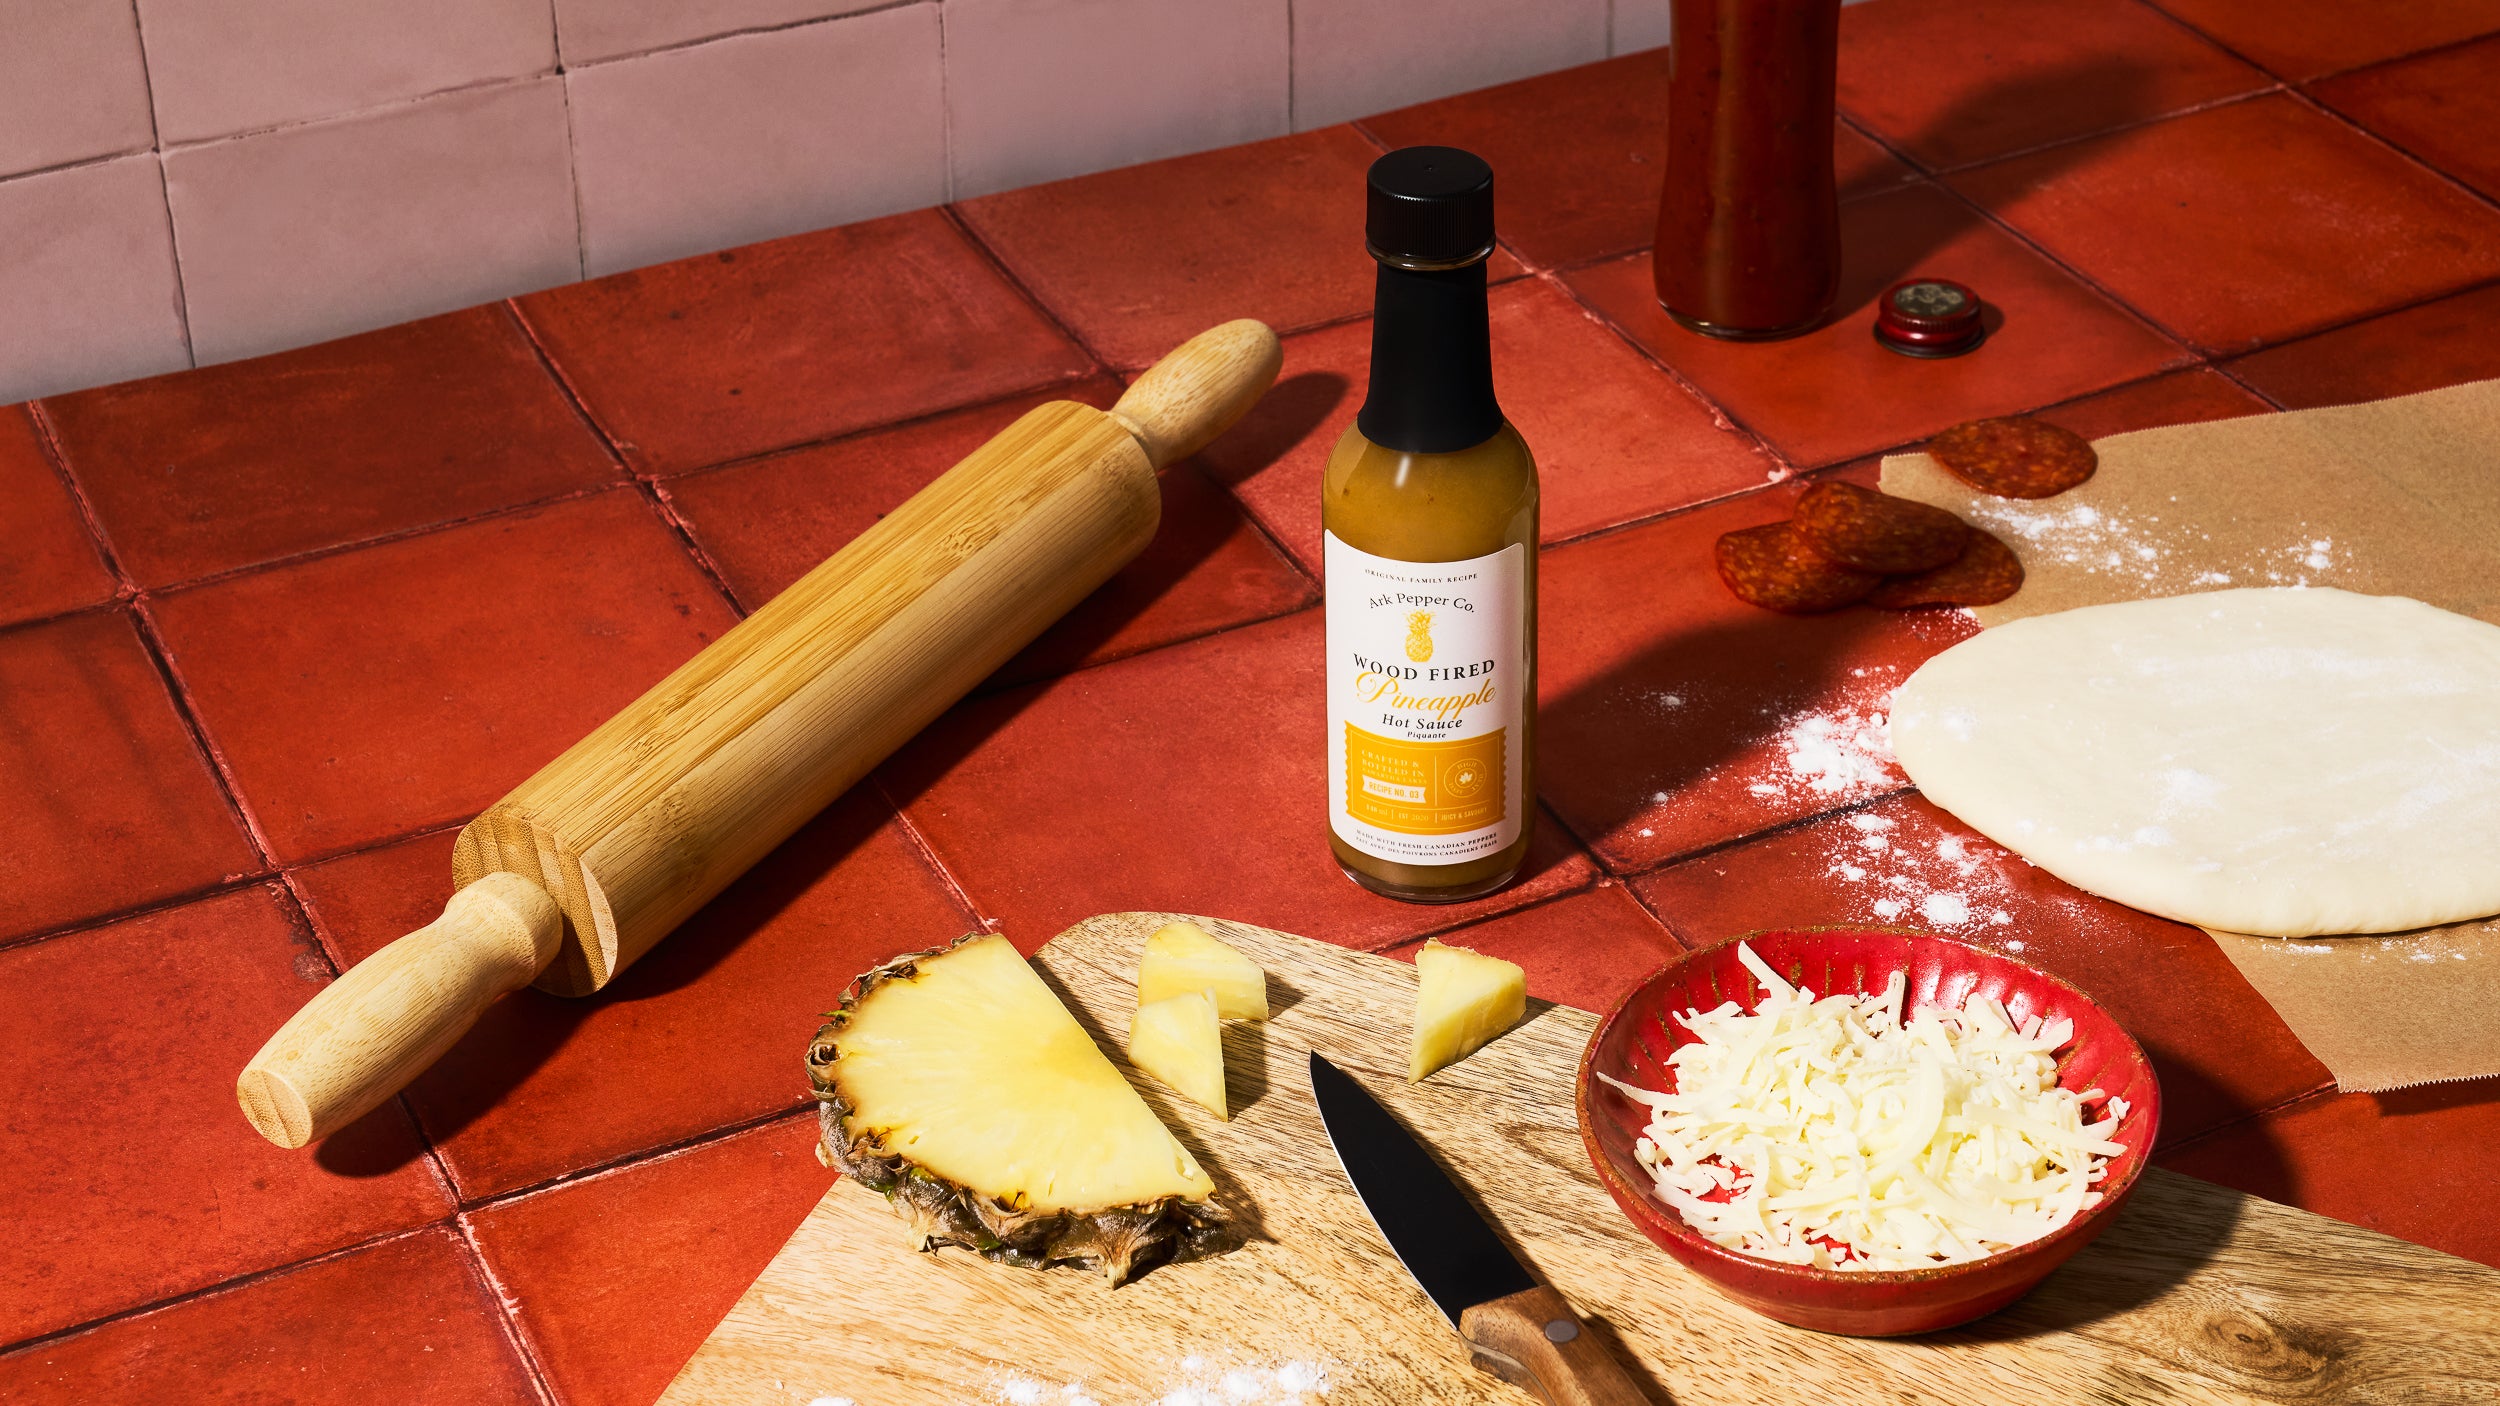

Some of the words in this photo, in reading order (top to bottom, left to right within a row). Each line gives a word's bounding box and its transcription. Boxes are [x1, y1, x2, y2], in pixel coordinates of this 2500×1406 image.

[1365, 568, 1406, 582] ORIGINAL
[1447, 573, 1478, 582] RECIPE
[1369, 594, 1393, 608] Ark
[1396, 592, 1450, 606] Pepper
[1454, 598, 1475, 613] Co.
[1353, 653, 1418, 680] WOOD
[1429, 659, 1495, 681] FIRED
[1356, 671, 1496, 720] Pineapple
[1382, 713, 1410, 728] Hot
[1416, 718, 1463, 730] Sauce
[1407, 731, 1446, 739] Piquante
[1361, 749, 1408, 766] CRAFTED
[1361, 758, 1408, 776] BOTTLED
[1368, 782, 1392, 794] RECIPE
[1394, 788, 1407, 797] NO.
[1410, 790, 1419, 798] 03
[1356, 829, 1374, 840] MADE
[1376, 838, 1395, 846] WITH
[1424, 842, 1466, 850] CANADIAN
[1468, 832, 1497, 845] PEPPERS
[1440, 846, 1478, 856] CANADIENS
[1480, 840, 1498, 849] FRAIS
